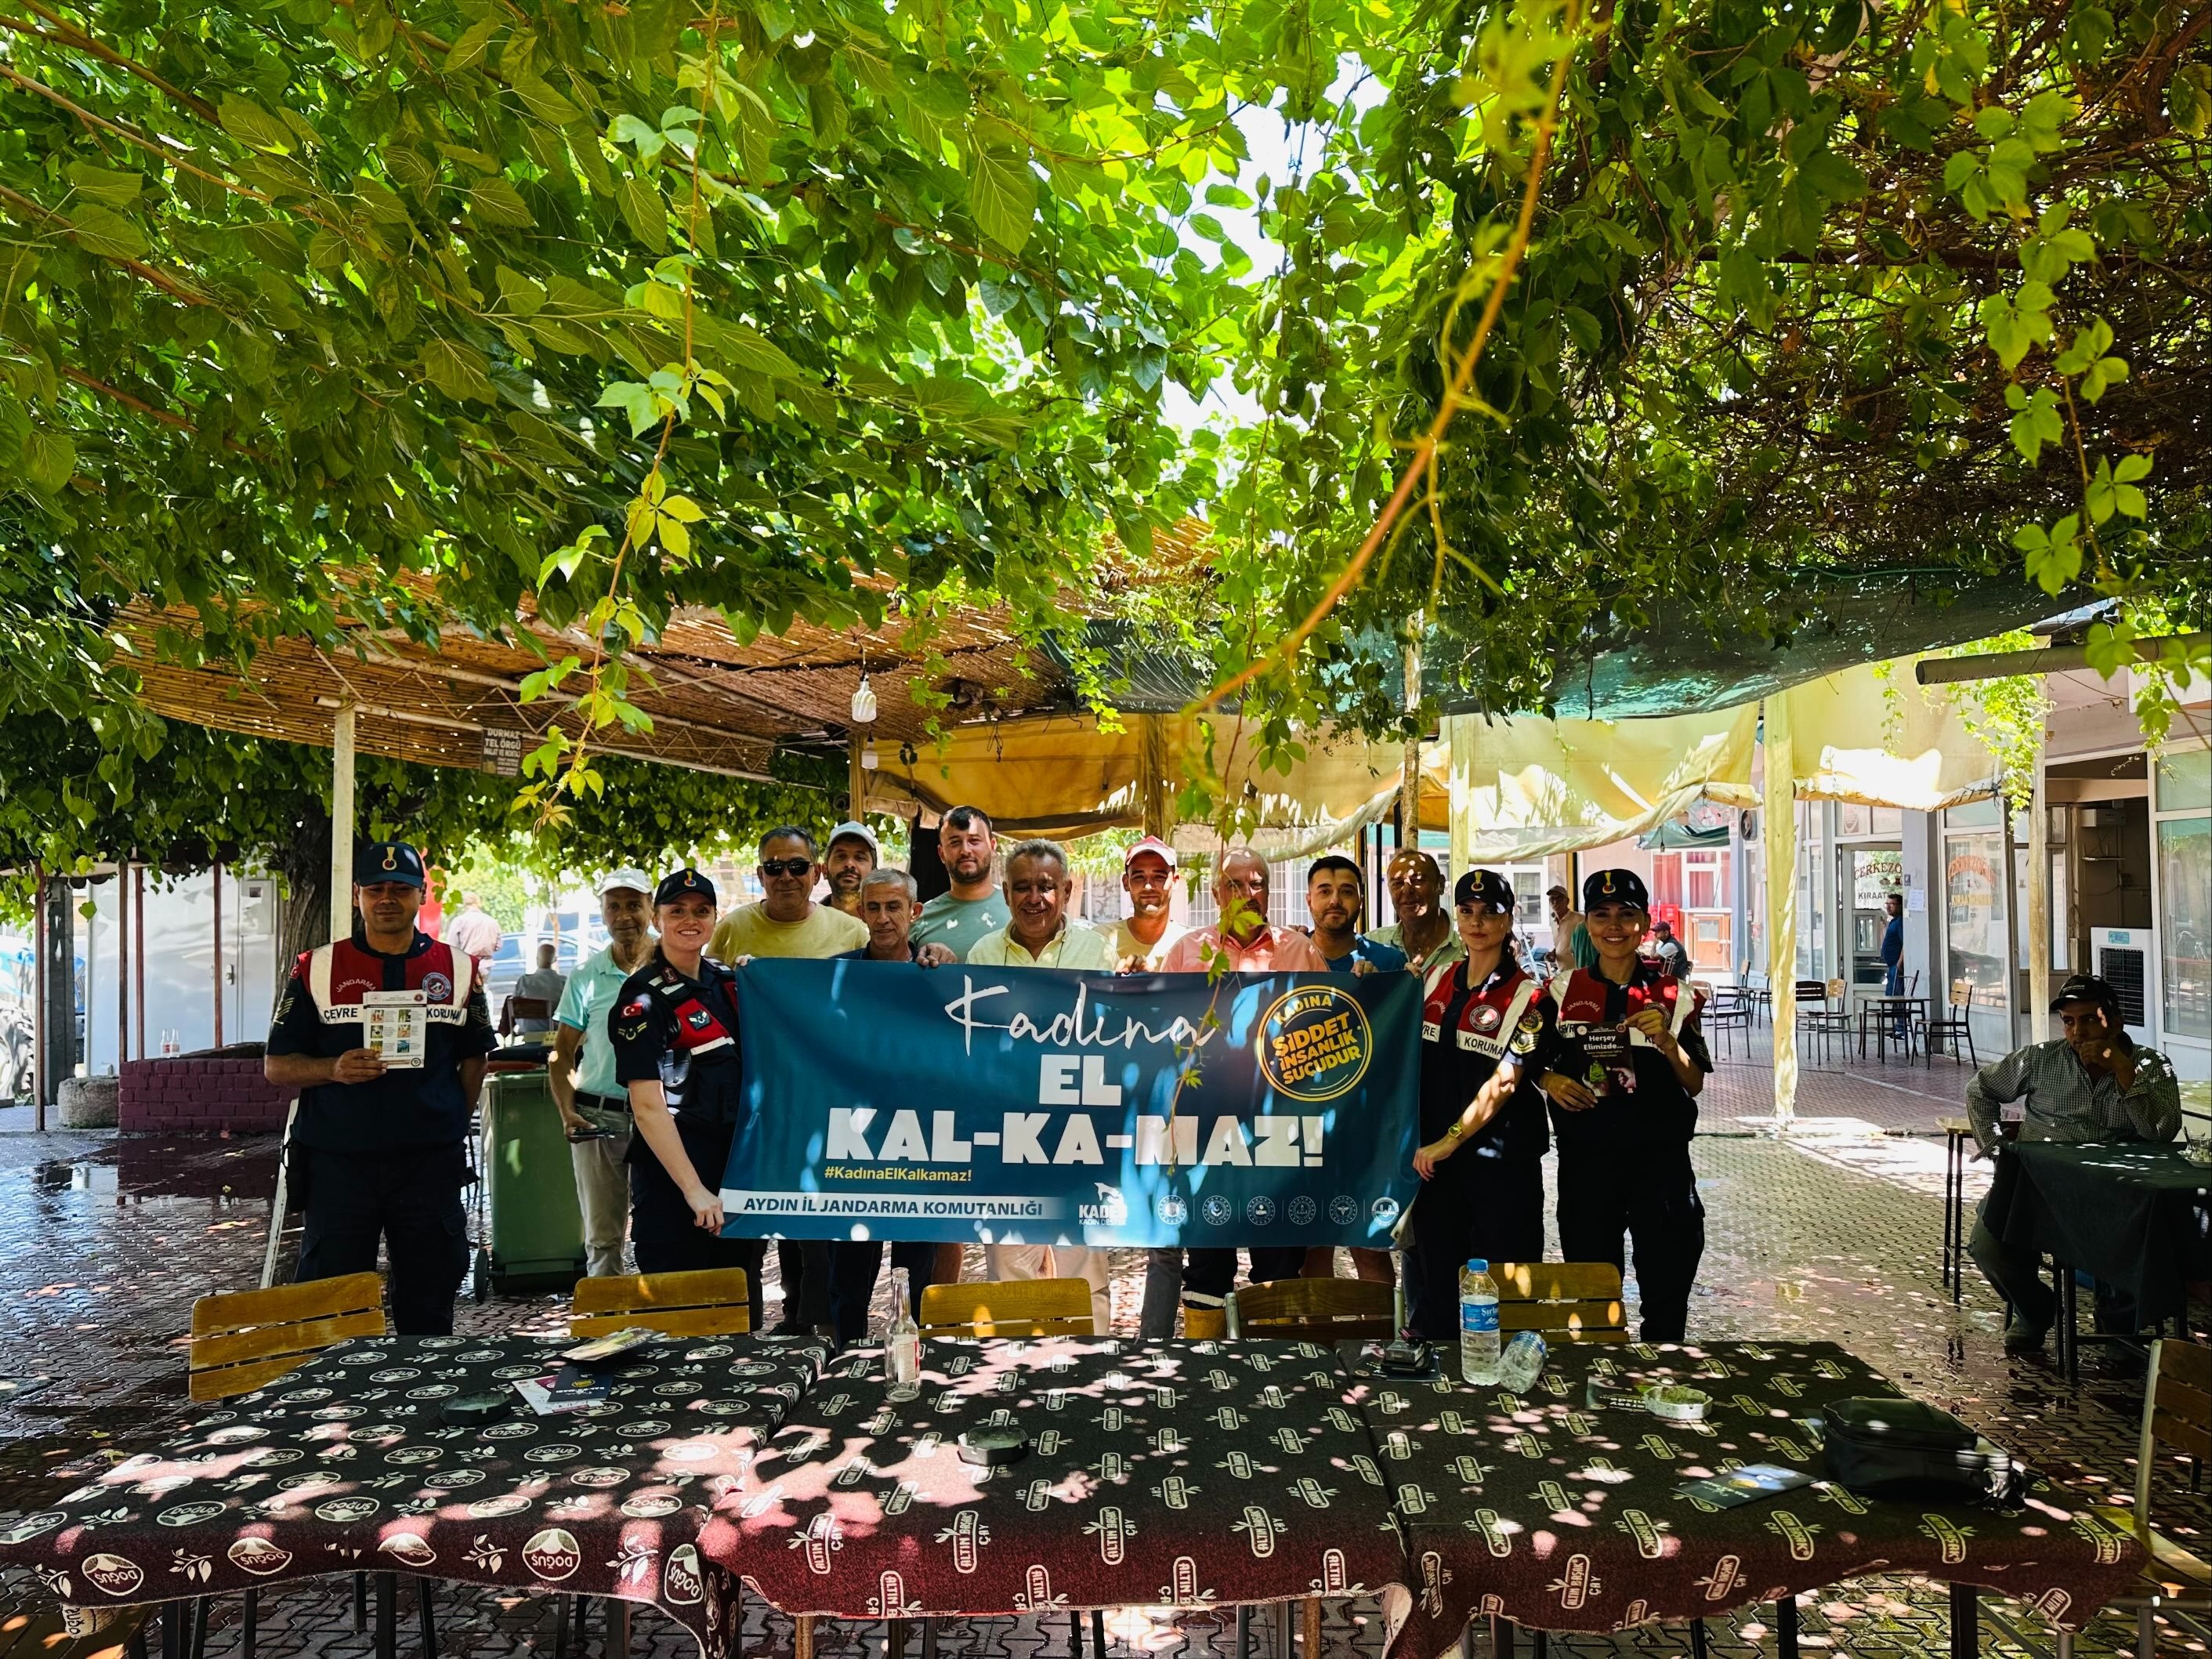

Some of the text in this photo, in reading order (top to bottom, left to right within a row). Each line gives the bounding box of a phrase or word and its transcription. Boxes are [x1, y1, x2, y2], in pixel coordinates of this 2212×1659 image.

[485, 738, 499, 748] TEL
[335, 979, 376, 993] JANDARMA
[324, 1008, 461, 1020] ÇEVRE KORUMA
[1273, 995, 1332, 1025] KADINA
[1567, 1000, 1600, 1012] JANDARMA
[943, 975, 1220, 1057] Kadına
[1273, 1012, 1350, 1056] ŞİDDET
[1279, 1029, 1358, 1070] İNSANLIK
[1464, 1037, 1503, 1056] KORUMA
[1283, 1045, 1362, 1085] SUÇUDUR
[1038, 1054, 1122, 1107] EL
[825, 1108, 1324, 1168] KAL-KA-MAZ!
[824, 1167, 972, 1182] #KadınaElKalkamaz!
[744, 1196, 1042, 1215] AYDIN İL JANDARMA KOMUTANLIĞI
[1079, 1204, 1127, 1219] KADE
[1481, 1307, 1499, 1317] Şırla
[534, 1447, 574, 1455] DOĞUŞ
[170, 1505, 219, 1515] DOĞUŞ
[326, 1501, 373, 1510] DOĞUŞ
[480, 1500, 524, 1509] DOĞUŞ
[632, 1498, 675, 1507] DOĞUŞ
[1124, 1519, 1138, 1537] ÇAY
[1272, 1517, 1289, 1533] ÇAY
[1613, 1520, 1631, 1534] ÇAY
[978, 1524, 991, 1546] ÇAY
[1106, 1530, 1119, 1559] ALTIN
[1254, 1528, 1270, 1552] ALTIN
[240, 1552, 288, 1565] DOĞUŞ
[959, 1536, 972, 1567] ALTIN
[531, 1554, 573, 1569] DOĞUŞ
[1328, 1555, 1341, 1586] ALTIN
[94, 1570, 139, 1585] DOĞUŞ
[668, 1564, 701, 1598] DOĞUŞ
[1178, 1562, 1192, 1593] ALTIN
[1571, 1558, 1586, 1586] BAŞAK
[885, 1575, 899, 1605] ALTIN
[1029, 1569, 1044, 1599] ALTIN
[1589, 1576, 1602, 1596] ÇAY
[866, 1597, 879, 1615] ÇA
